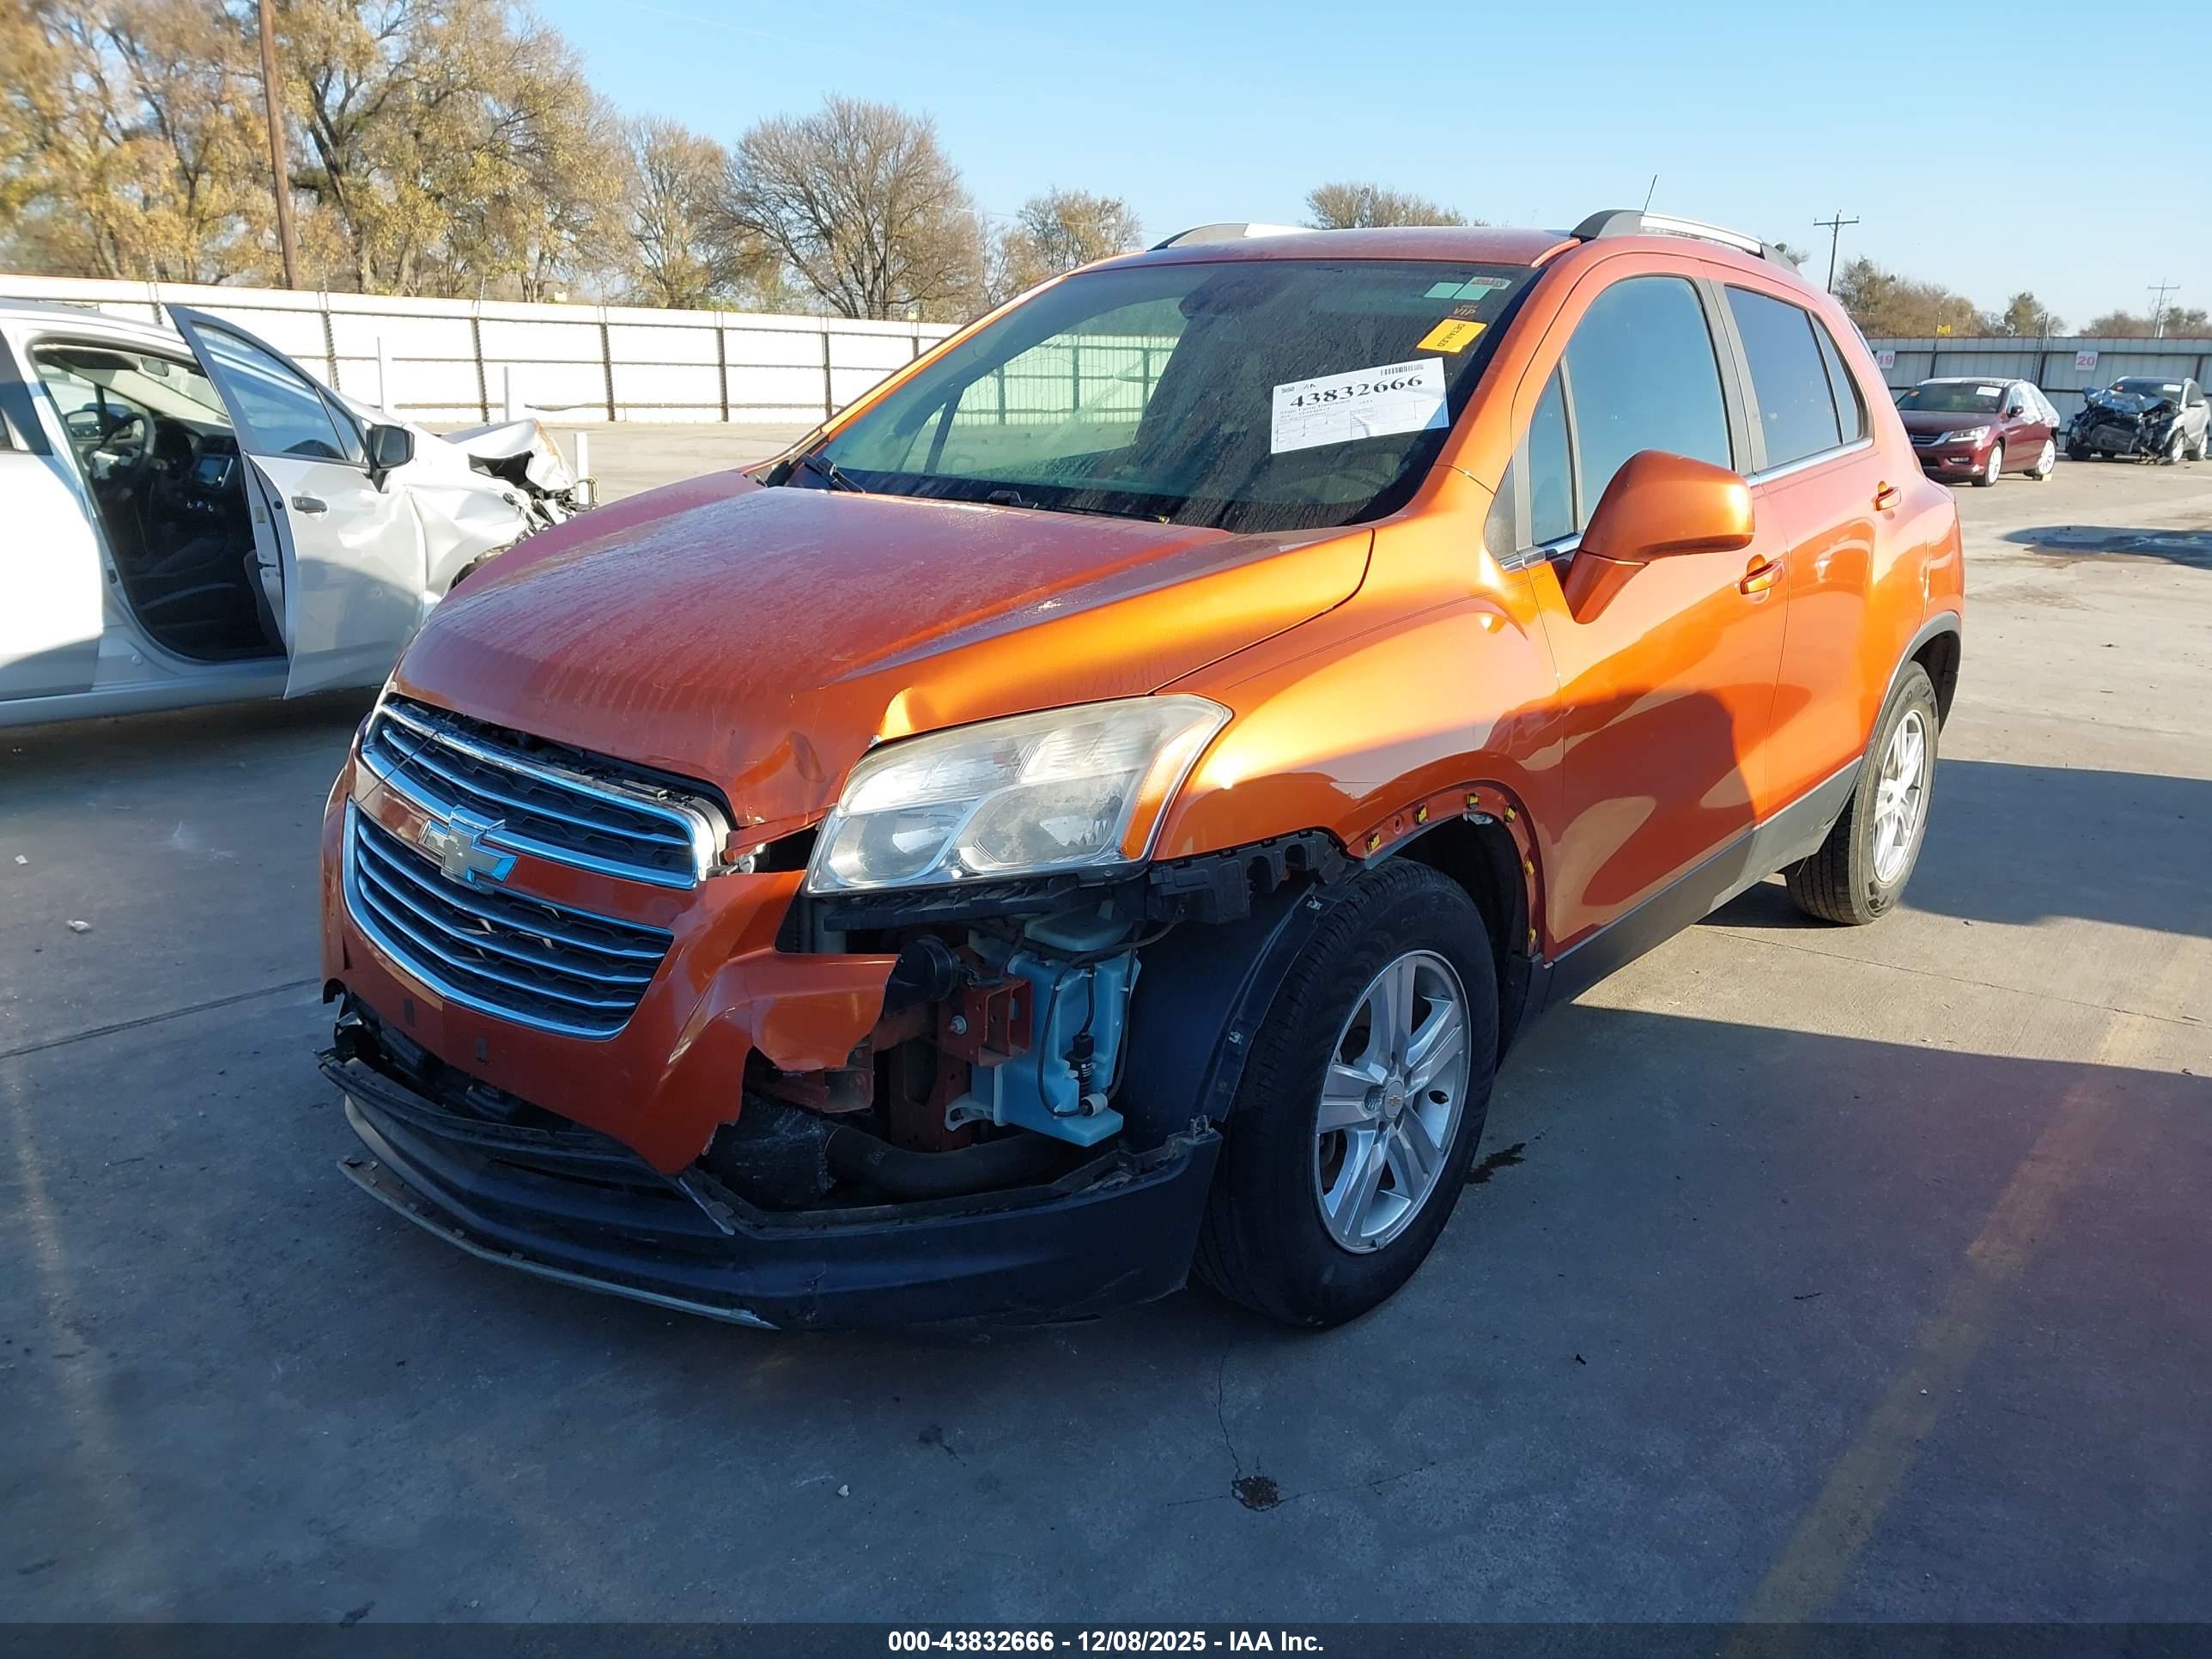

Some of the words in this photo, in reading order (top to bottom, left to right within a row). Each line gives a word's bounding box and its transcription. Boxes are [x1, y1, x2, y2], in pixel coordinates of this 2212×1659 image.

[1453, 307, 1477, 316] VIP
[1437, 323, 1466, 348] DETAILED
[1877, 355, 1893, 365] 19
[2077, 356, 2095, 366] 20
[1290, 374, 1423, 407] 43832666
